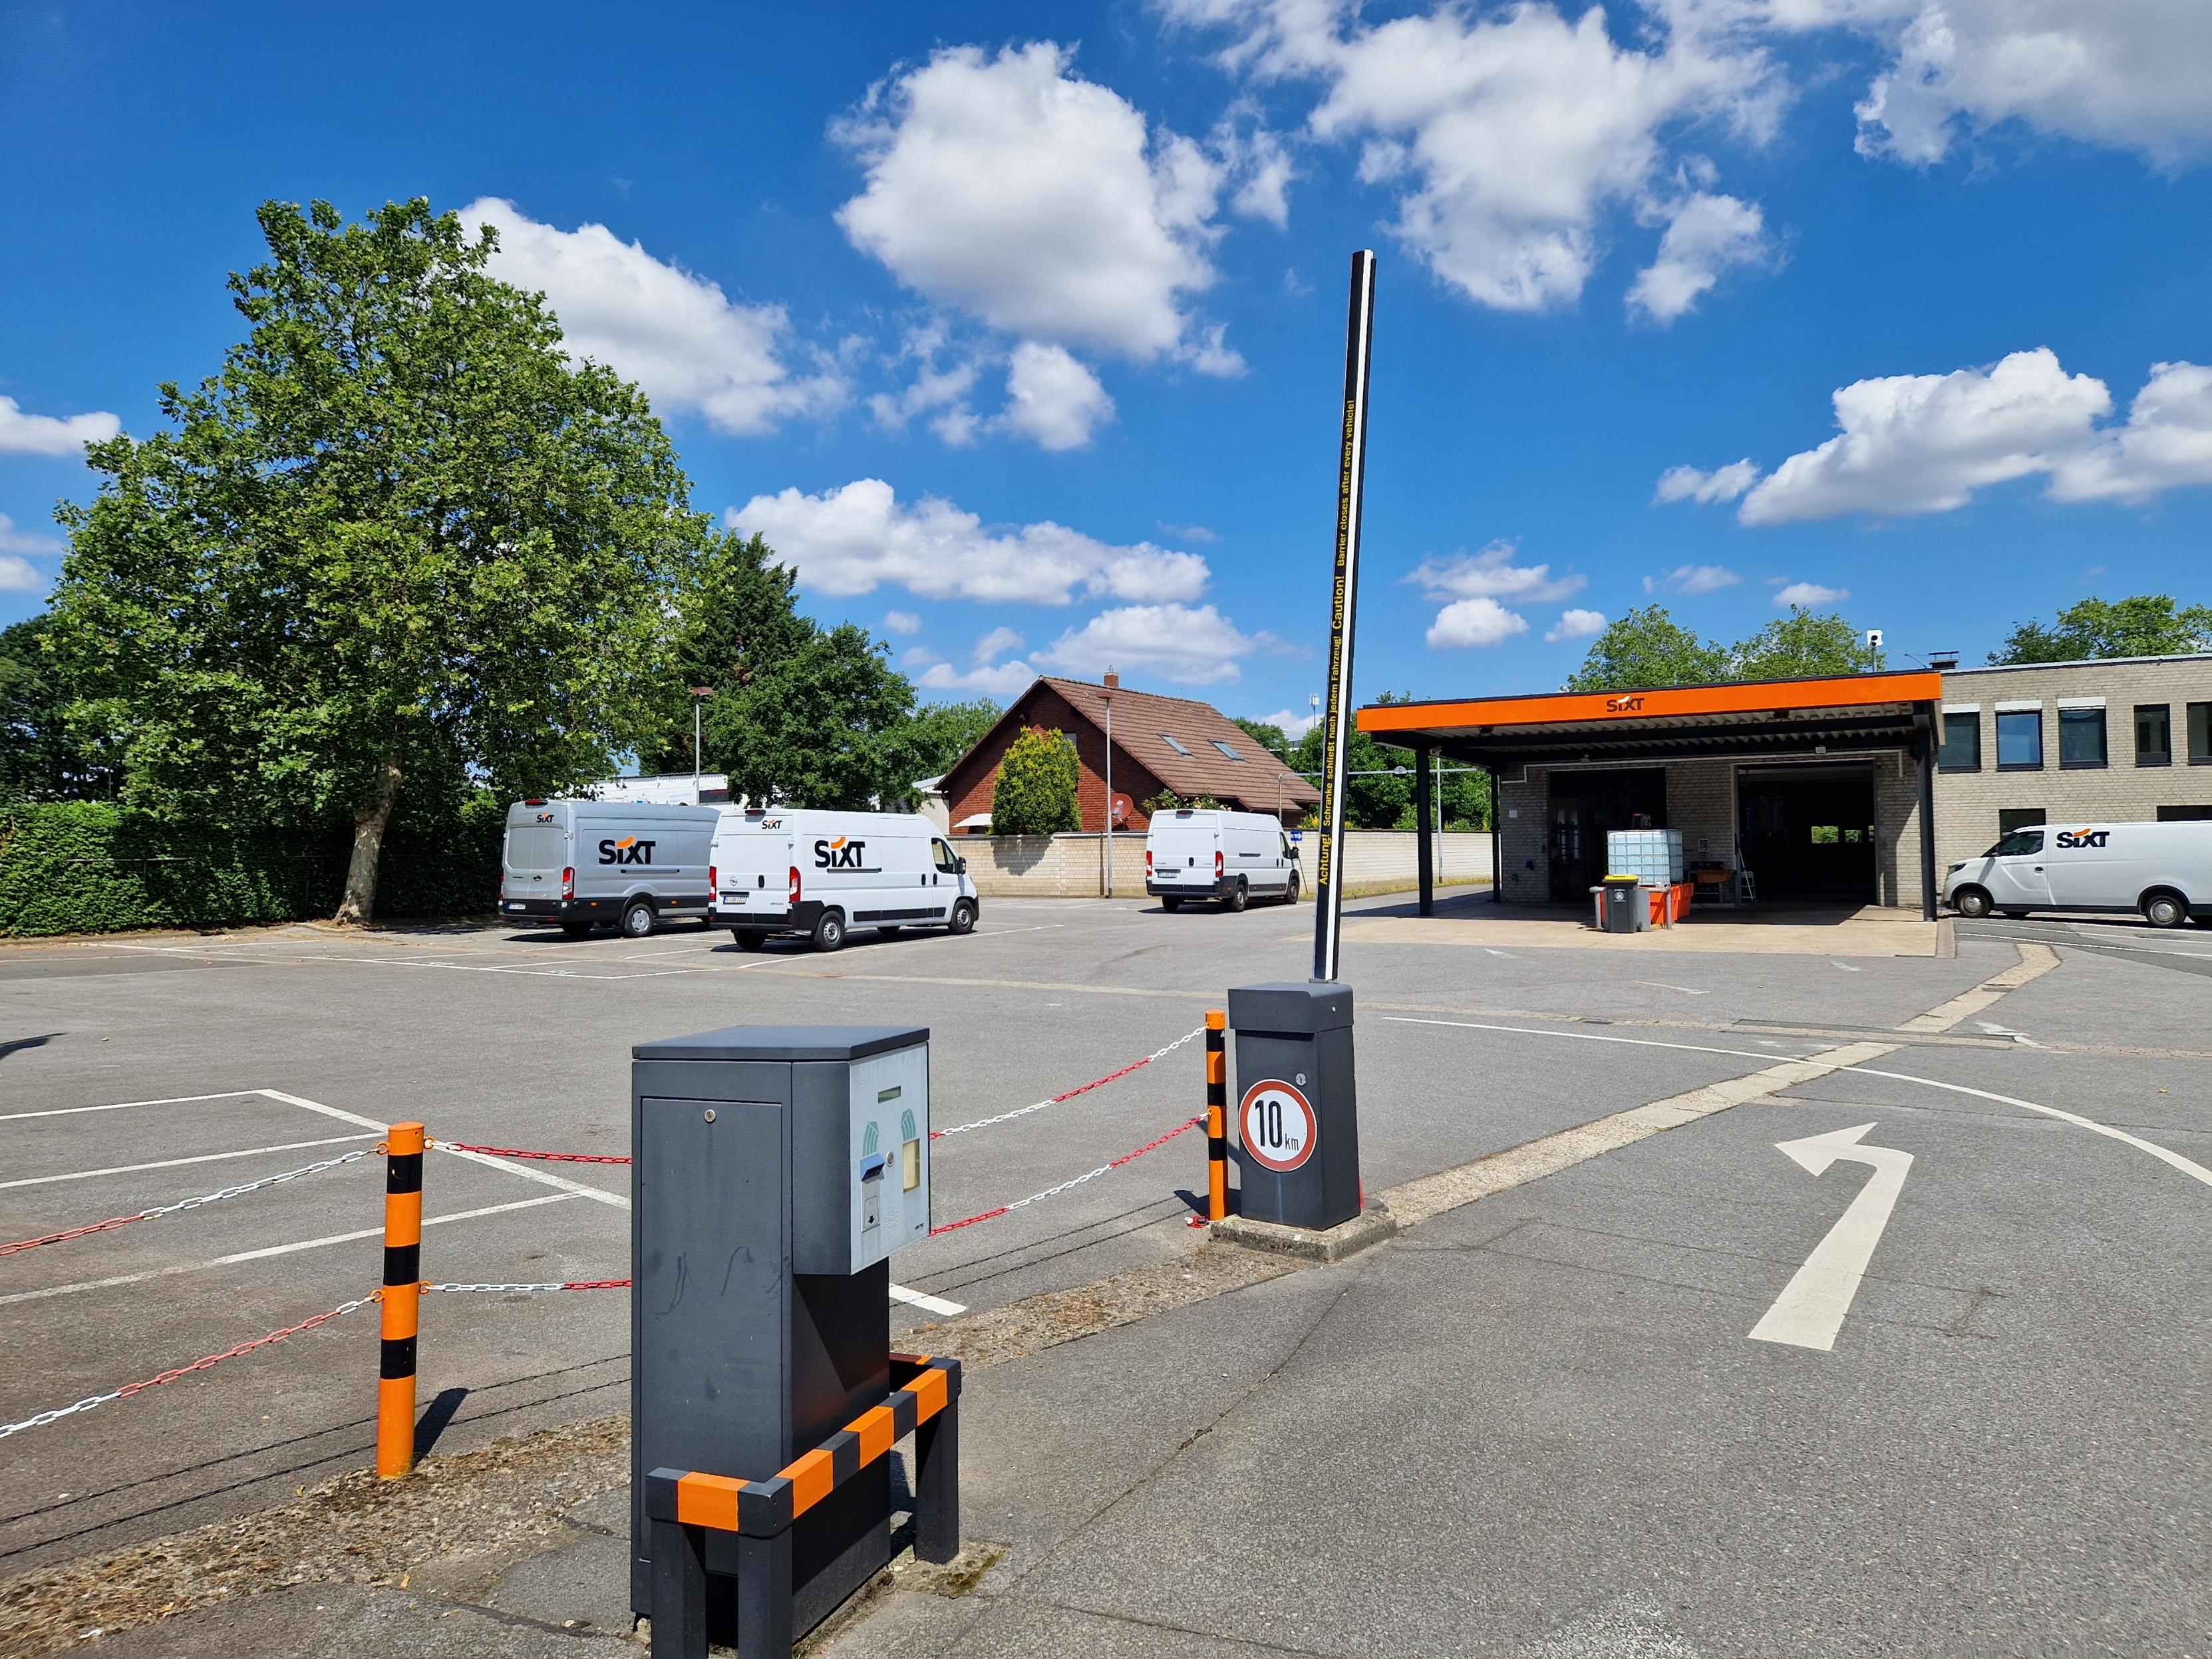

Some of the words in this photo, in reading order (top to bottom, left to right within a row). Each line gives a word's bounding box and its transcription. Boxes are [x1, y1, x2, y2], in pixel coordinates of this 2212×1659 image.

[1345, 400, 1354, 438] vehicle!
[1344, 441, 1352, 468] every
[1340, 497, 1348, 530] closes
[1337, 533, 1346, 567] Barrier
[1333, 576, 1344, 630] Caution!
[1331, 636, 1342, 681] Fahrzeug!
[1329, 684, 1339, 714] jedem
[1327, 741, 1335, 780] schließt
[1323, 782, 1333, 828] Schranke
[1319, 833, 1333, 885] Achtung!
[1255, 1100, 1283, 1148] 10
[1285, 1133, 1299, 1151] km
